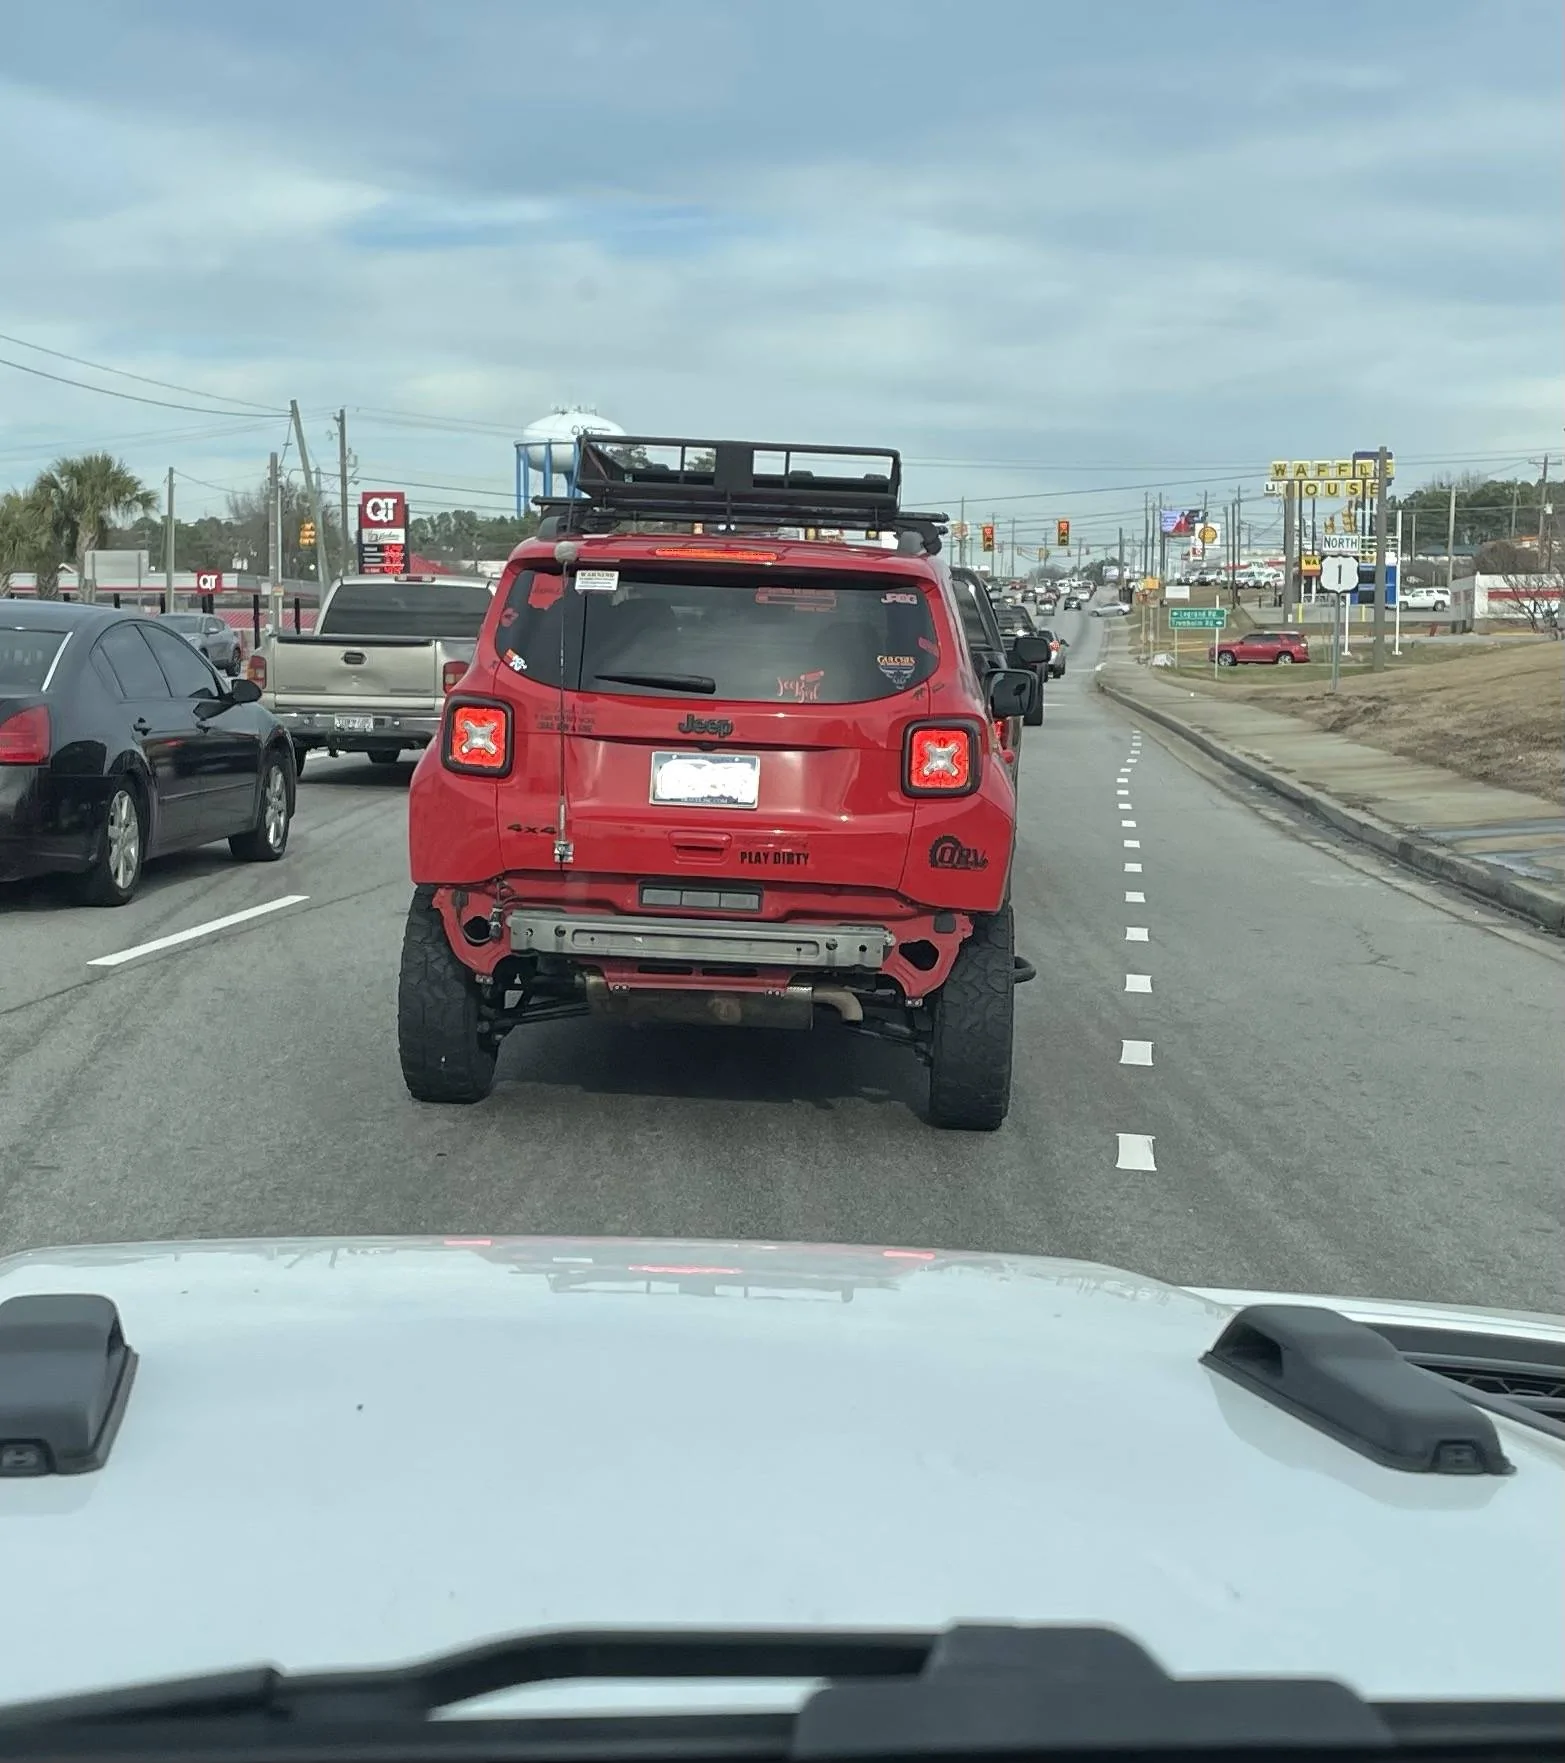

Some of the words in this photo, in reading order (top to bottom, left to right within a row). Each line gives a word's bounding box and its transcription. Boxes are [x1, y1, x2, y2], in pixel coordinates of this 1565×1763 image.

[1286, 483, 1380, 496] OUSE
[366, 498, 398, 523] QT
[1323, 536, 1358, 548] NORTH
[1337, 564, 1343, 585] 1
[199, 575, 218, 590] QT
[679, 713, 733, 738] Jeep
[507, 824, 557, 835] 4x4
[740, 851, 769, 865] PLAY
[773, 851, 810, 866] DIRTY
